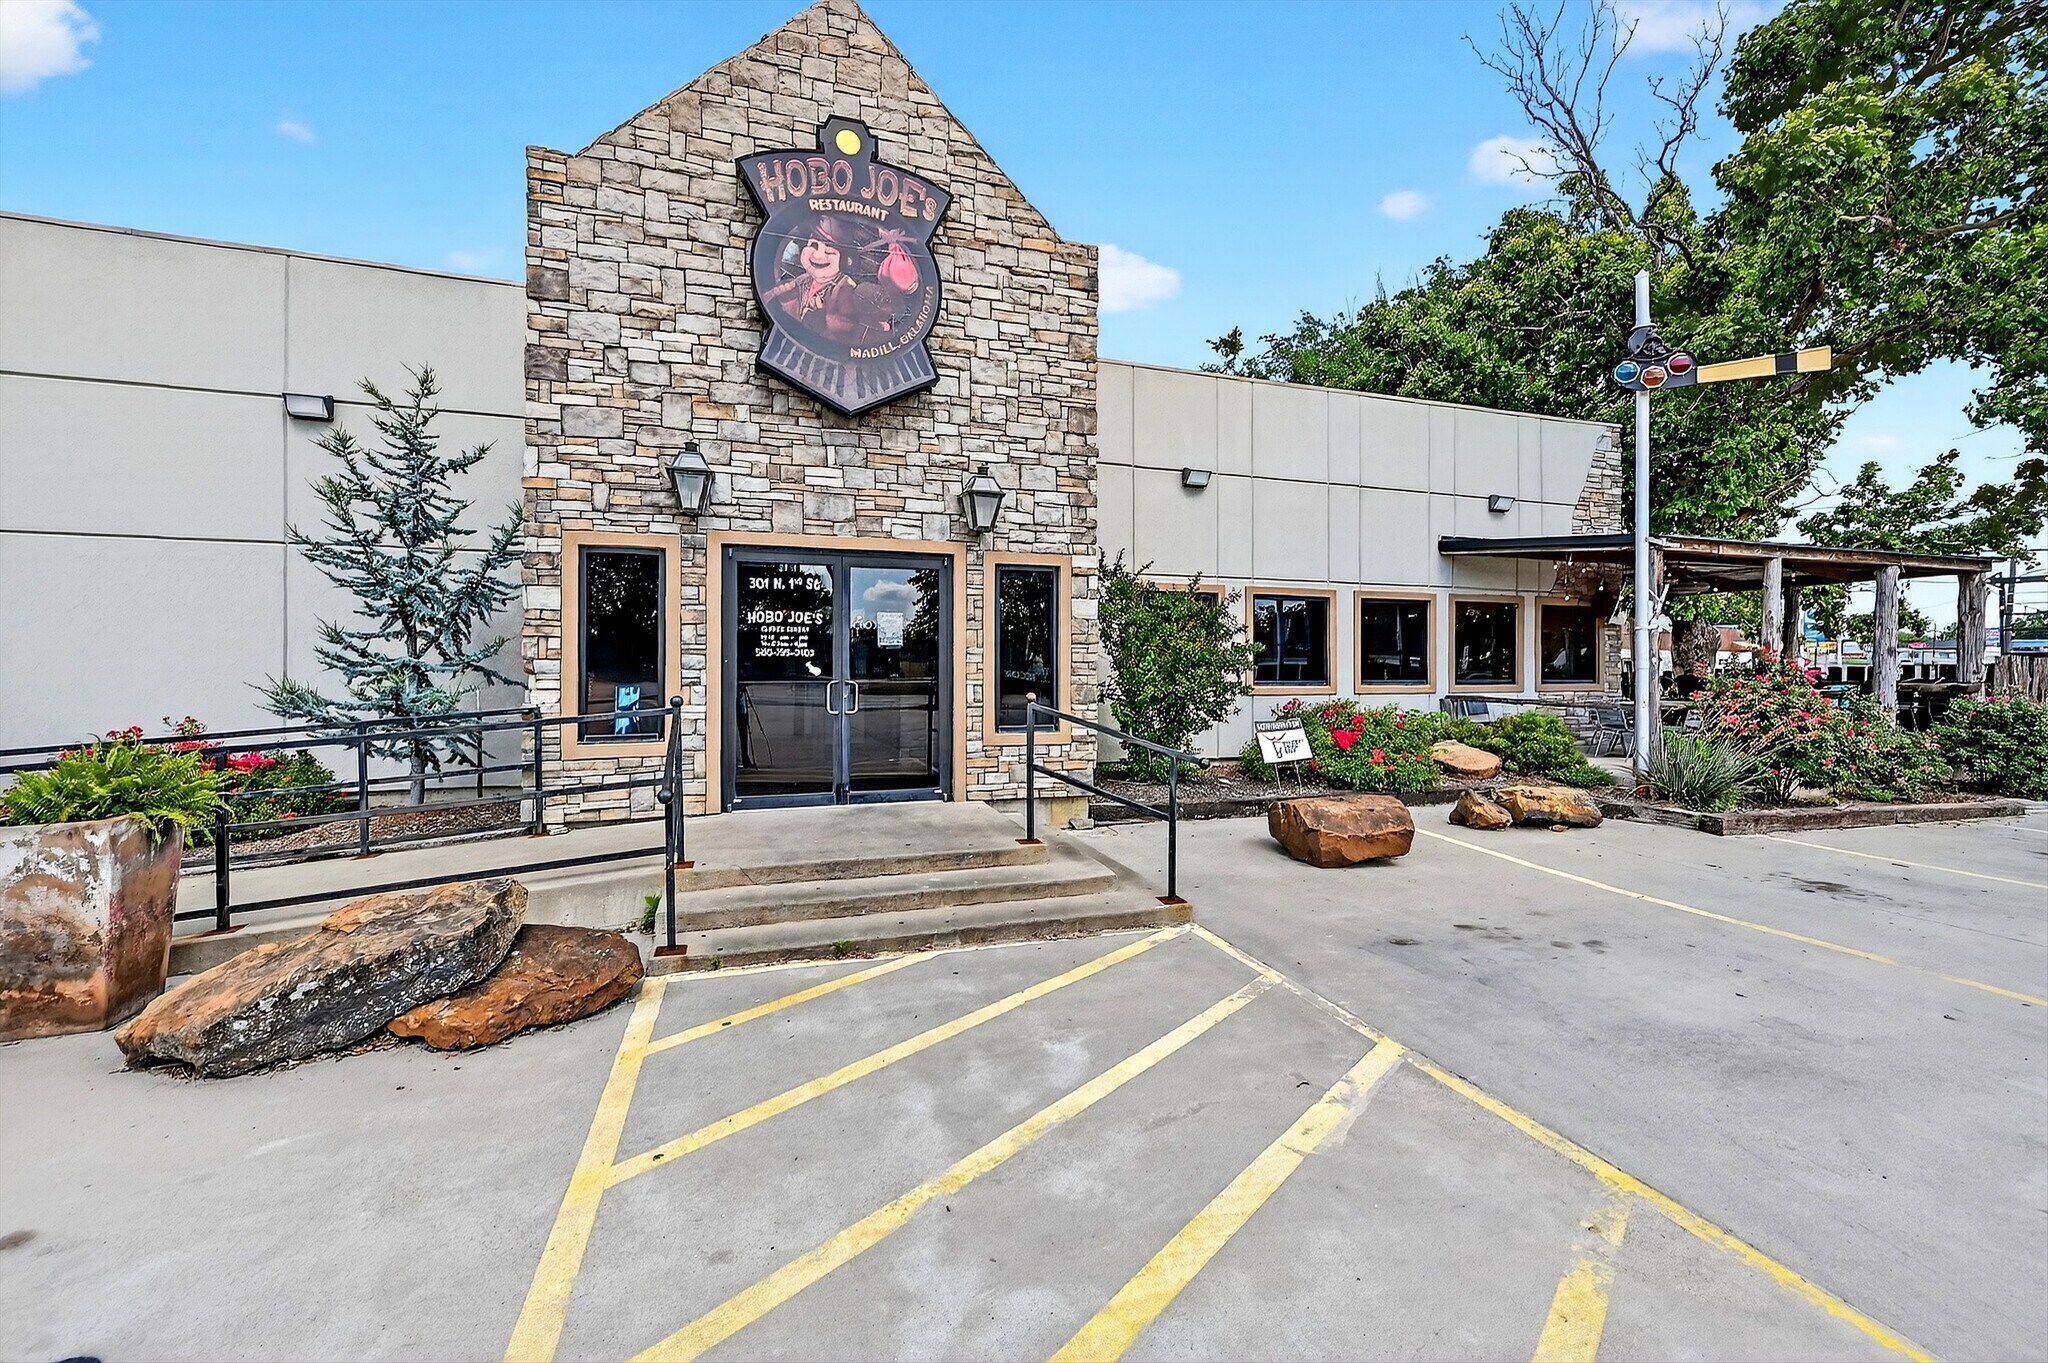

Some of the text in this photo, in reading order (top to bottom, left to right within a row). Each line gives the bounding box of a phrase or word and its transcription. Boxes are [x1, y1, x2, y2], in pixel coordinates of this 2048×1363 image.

[757, 157, 853, 202] HOBO
[809, 199, 889, 221] RESTAURANT
[749, 577, 770, 590] 301
[747, 610, 824, 625] HOBO JOE'S
